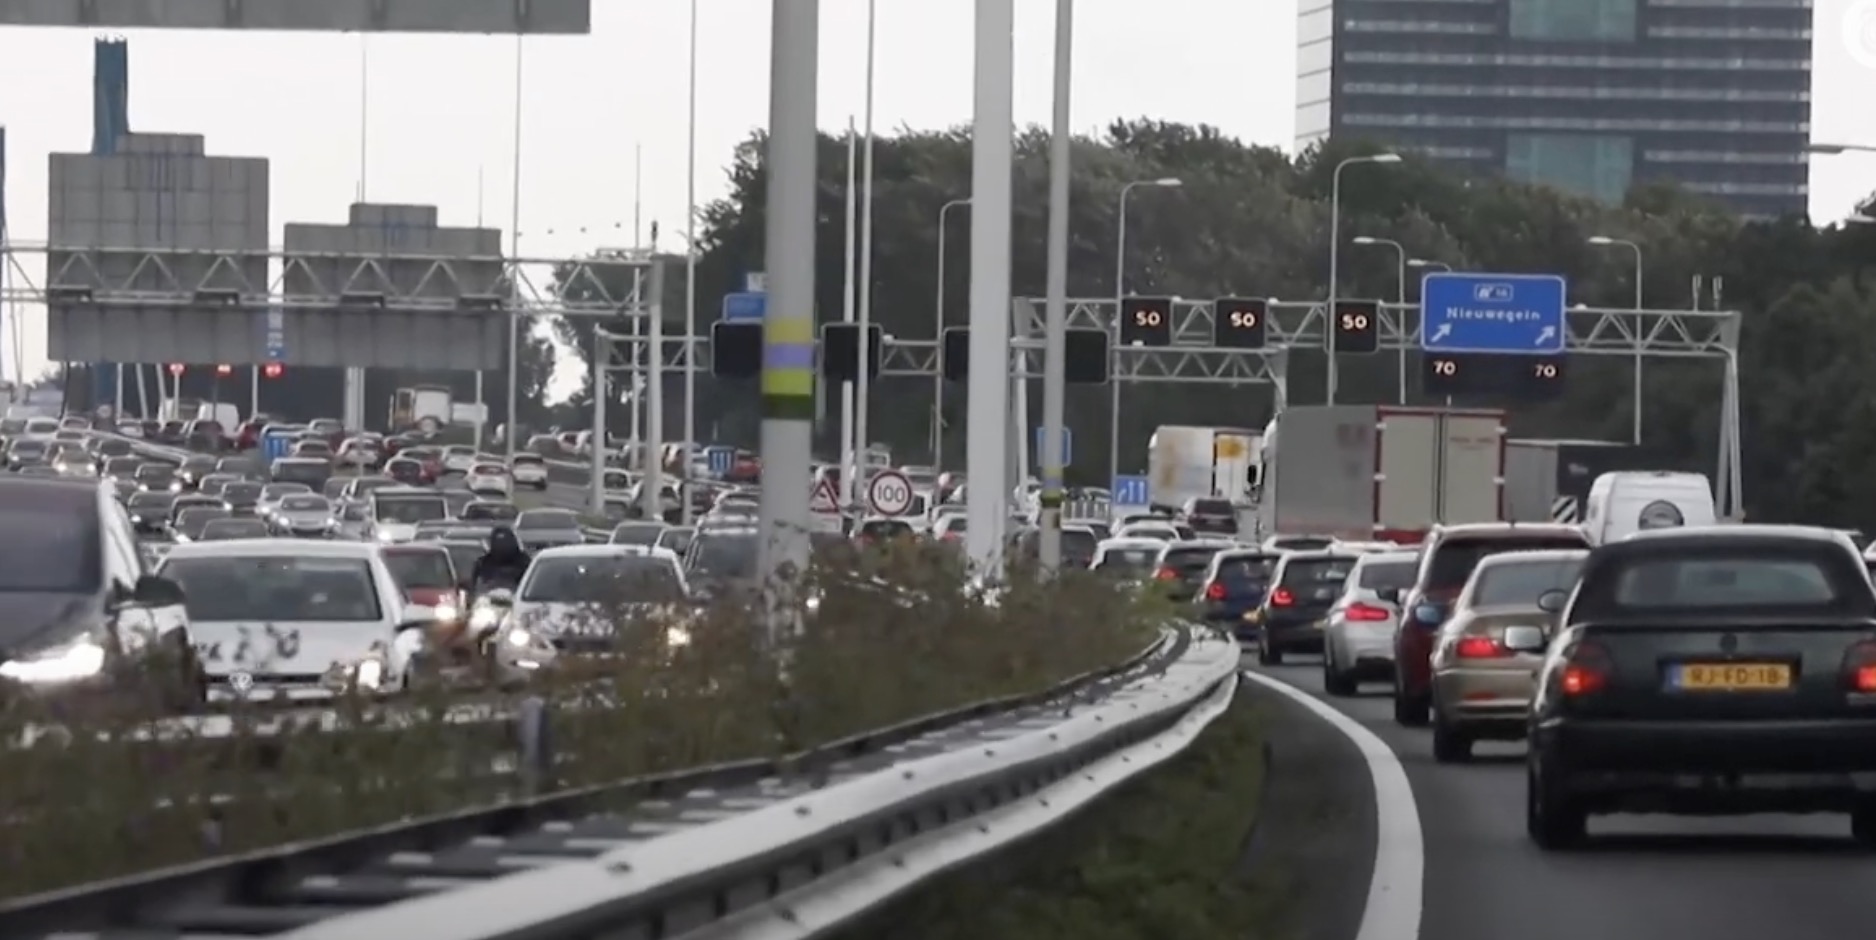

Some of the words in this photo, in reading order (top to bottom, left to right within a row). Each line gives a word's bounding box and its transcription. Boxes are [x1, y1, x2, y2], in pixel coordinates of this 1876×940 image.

[1135, 311, 1160, 326] 50
[1230, 312, 1255, 327] 50
[1342, 314, 1367, 330] 50
[1446, 307, 1541, 322] Nieuwegein
[1433, 360, 1456, 375] 70
[1535, 364, 1556, 378] 70
[878, 485, 905, 503] 100
